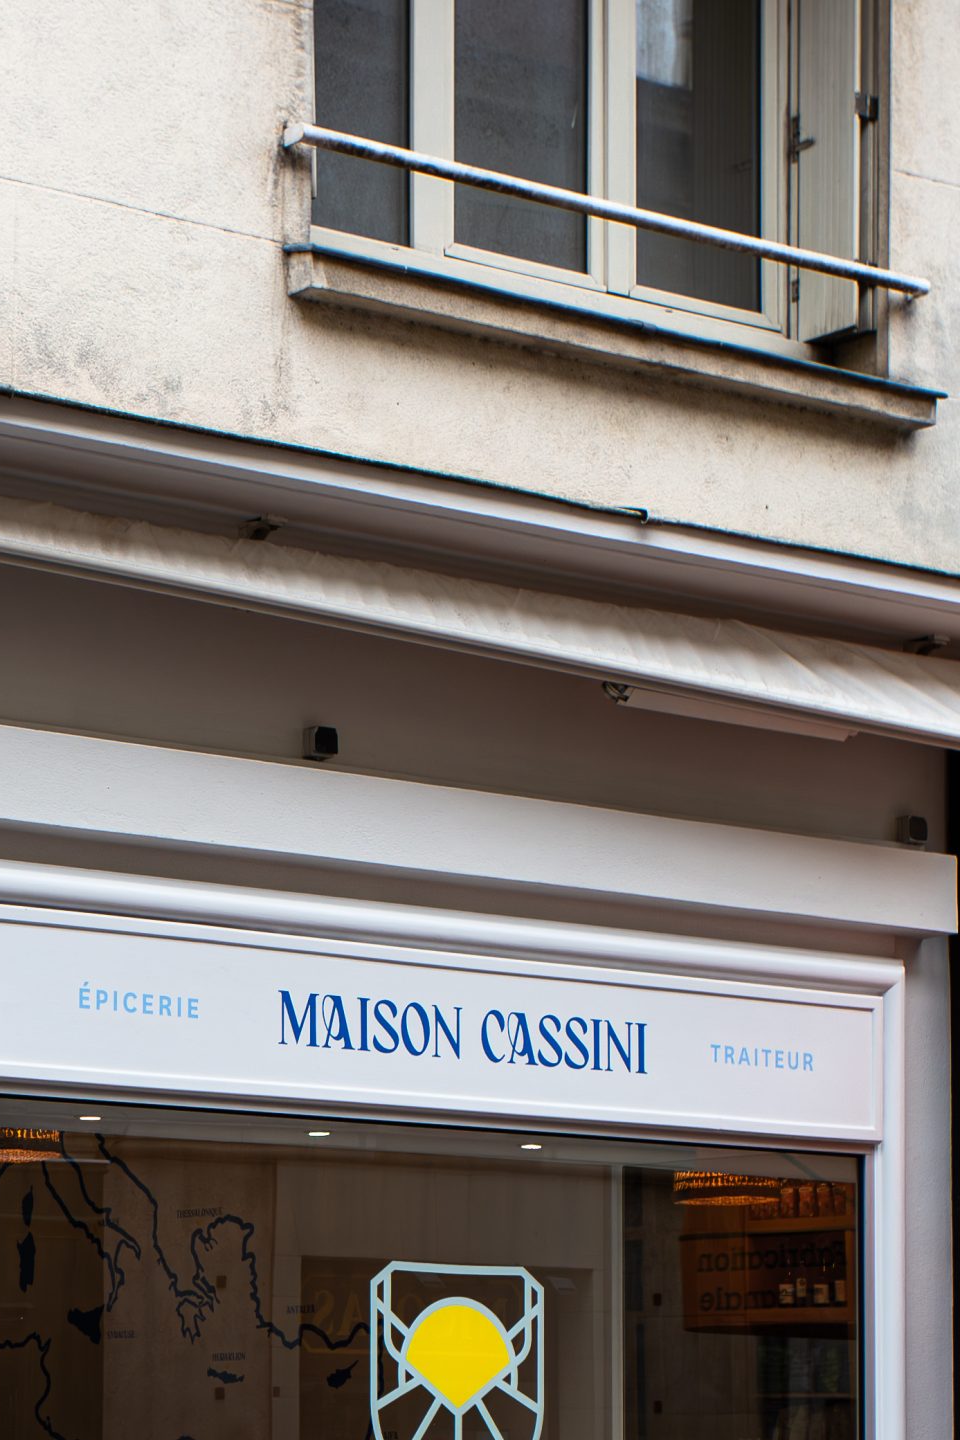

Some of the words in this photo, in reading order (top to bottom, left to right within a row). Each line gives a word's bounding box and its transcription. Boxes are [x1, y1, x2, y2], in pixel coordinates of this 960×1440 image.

[78, 981, 200, 1020] ÉPICERIE
[278, 989, 462, 1060] MAISON
[481, 1009, 648, 1074] CASSINI
[710, 1043, 814, 1072] TRAITEUR
